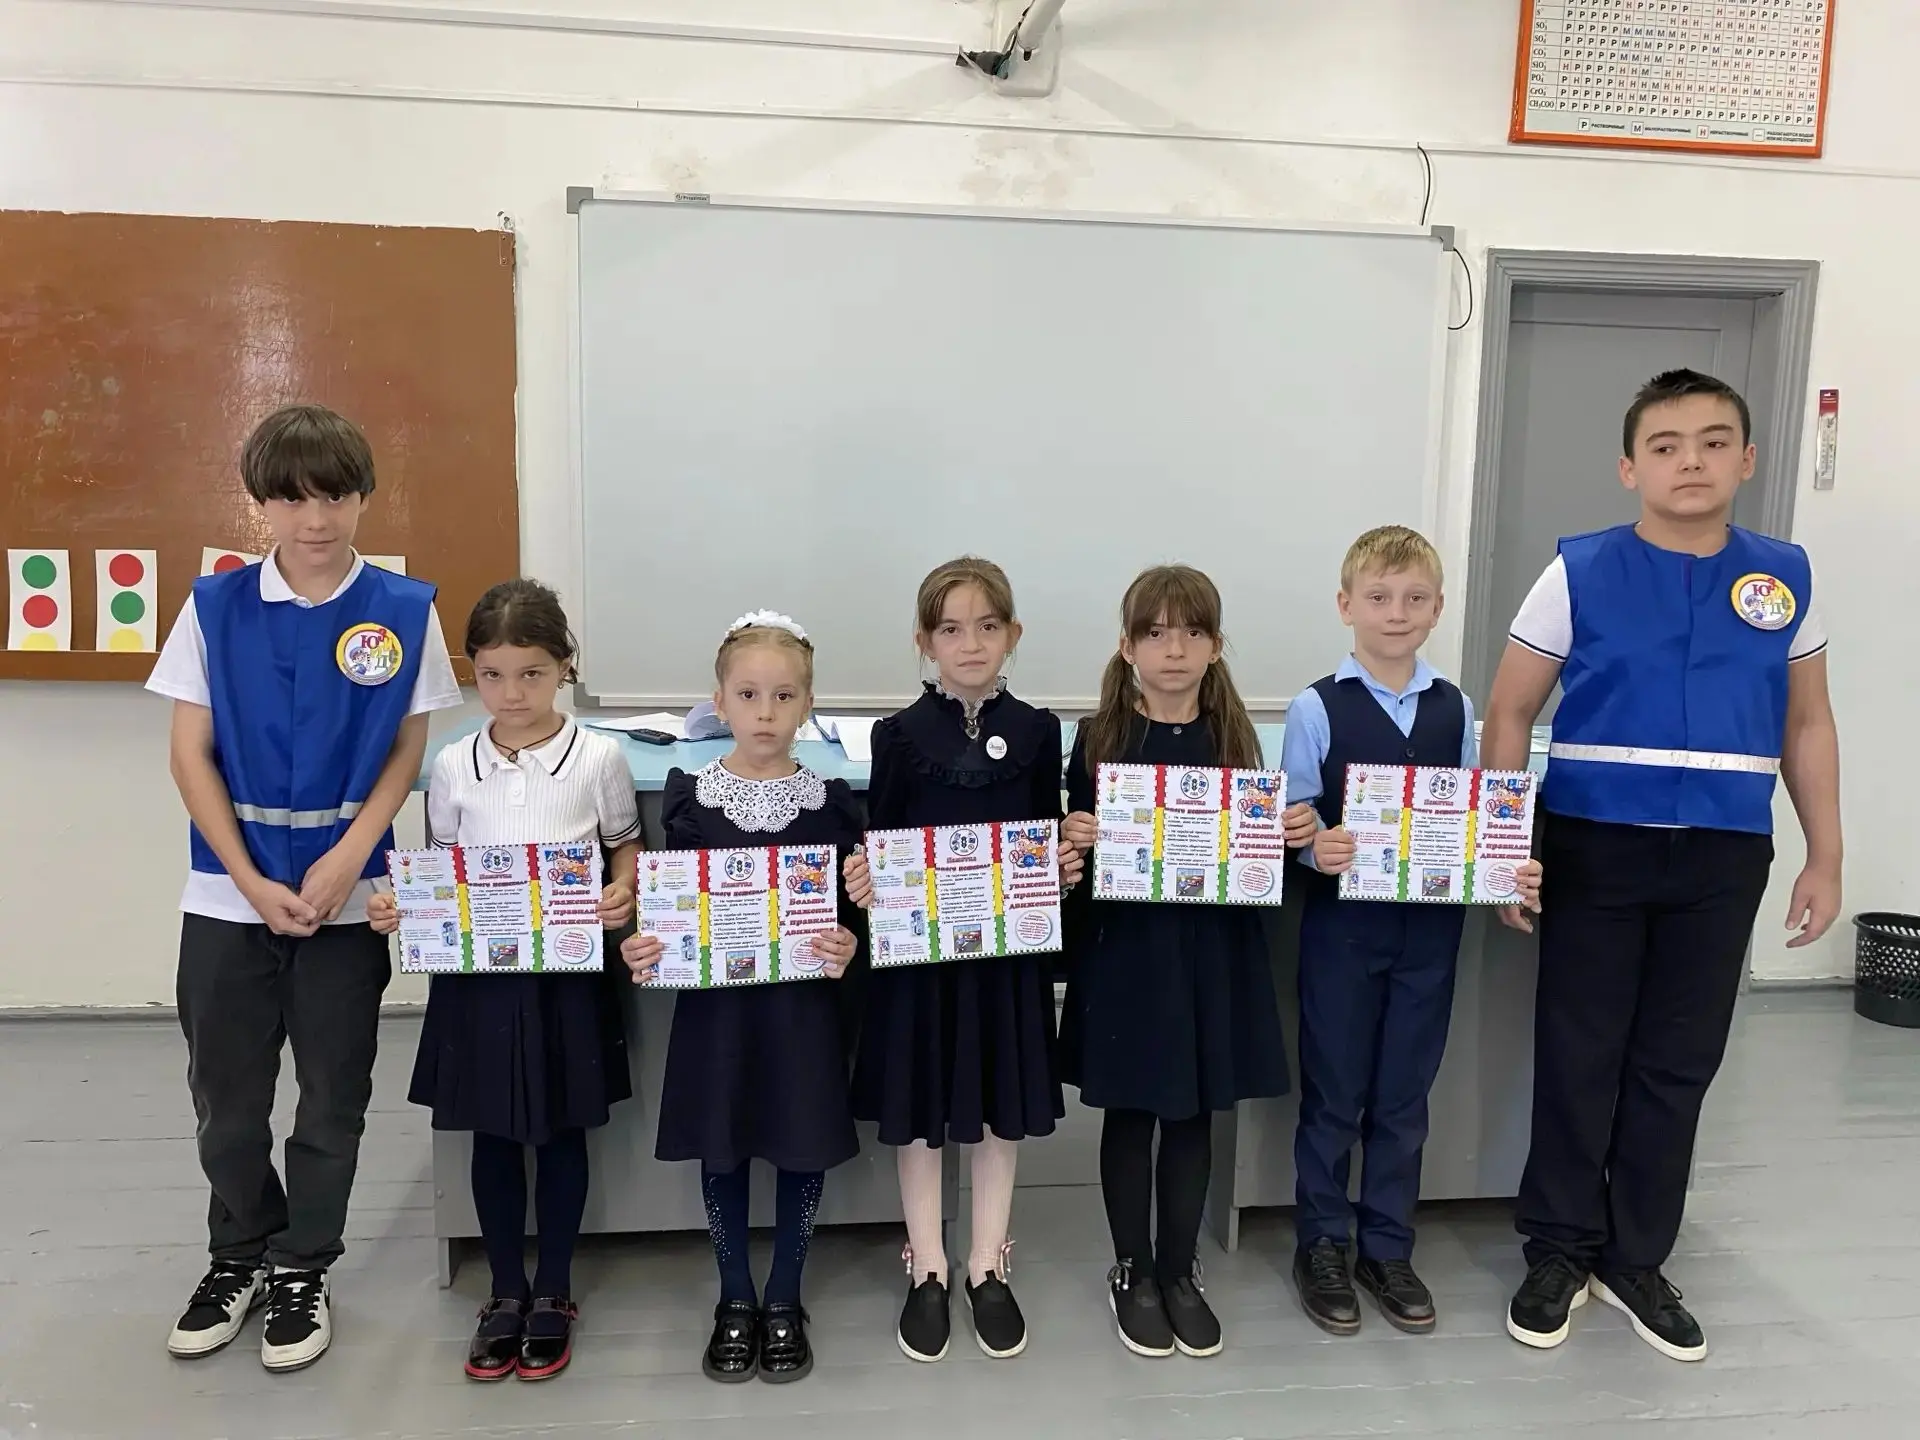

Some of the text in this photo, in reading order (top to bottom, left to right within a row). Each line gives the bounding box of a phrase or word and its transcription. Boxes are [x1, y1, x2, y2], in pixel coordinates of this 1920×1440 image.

[1582, 121, 1587, 129] Р
[1239, 821, 1274, 829] Больше
[1487, 822, 1521, 830] Больше
[1009, 881, 1056, 890] уважения
[548, 899, 599, 907] уважения
[789, 898, 826, 906] Больше
[1009, 901, 1057, 910] движения
[553, 909, 597, 917] правила
[785, 908, 833, 917] уважения
